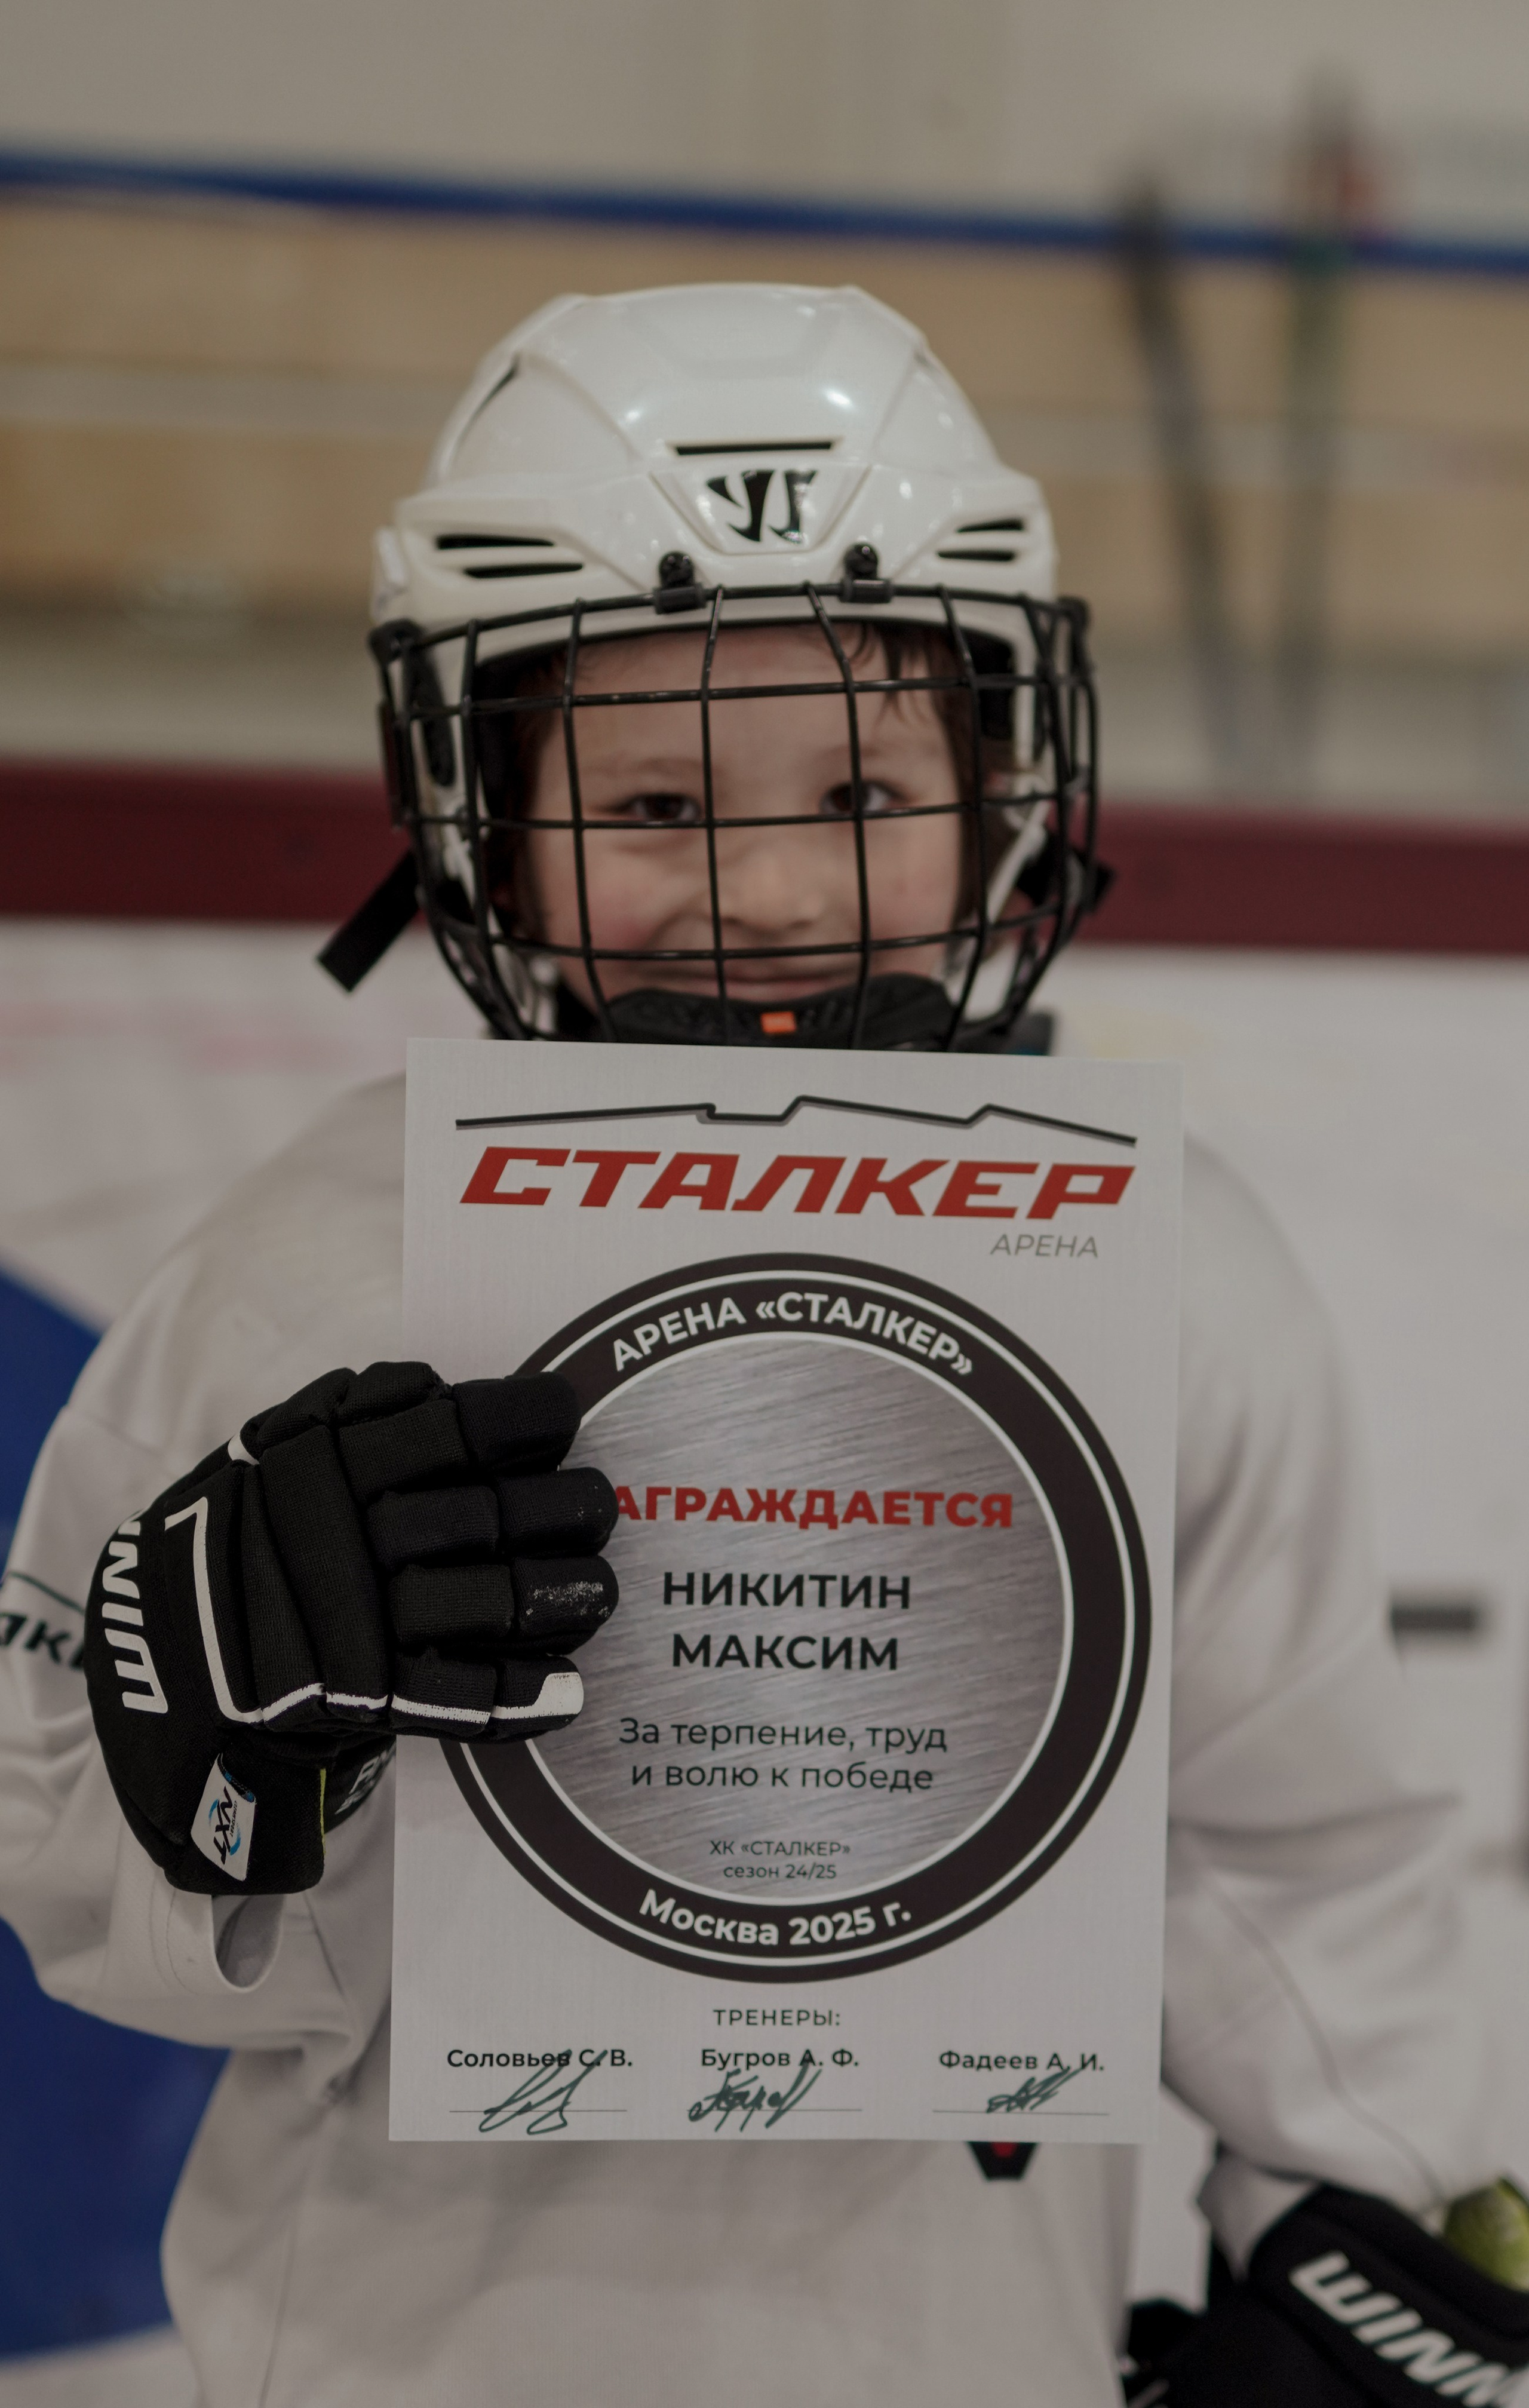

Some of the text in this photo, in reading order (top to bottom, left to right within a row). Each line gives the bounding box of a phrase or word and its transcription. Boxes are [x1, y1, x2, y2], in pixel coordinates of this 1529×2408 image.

[459, 1146, 1136, 1220] СТАЛКЕР
[989, 1233, 1099, 1259] АРЕНА
[612, 1292, 974, 1376] АРЕНА «СТАЛКЕР»
[614, 1485, 1014, 1531] АГРАЖДАЕТСЯ
[662, 1571, 911, 1611] НИКИТИН
[672, 1633, 899, 1671] МАКСИМ
[618, 1716, 948, 1755] За терпение, труд
[631, 1760, 935, 1794] и волю к победе
[213, 1786, 233, 1865] NXT
[709, 1839, 852, 1857] ХК «СТАЛКЕР»
[722, 1862, 837, 1881] сезон 24/25
[638, 1888, 912, 1946] Москва 2025 г.
[713, 2008, 841, 2027] ТРЕНЕРЫ:
[447, 2049, 571, 2067] Соловьев
[610, 2049, 633, 2067] В.
[701, 2048, 859, 2070] Бугров А. Ф.
[939, 2050, 1038, 2072] Фадеев
[1080, 2053, 1104, 2072] И.
